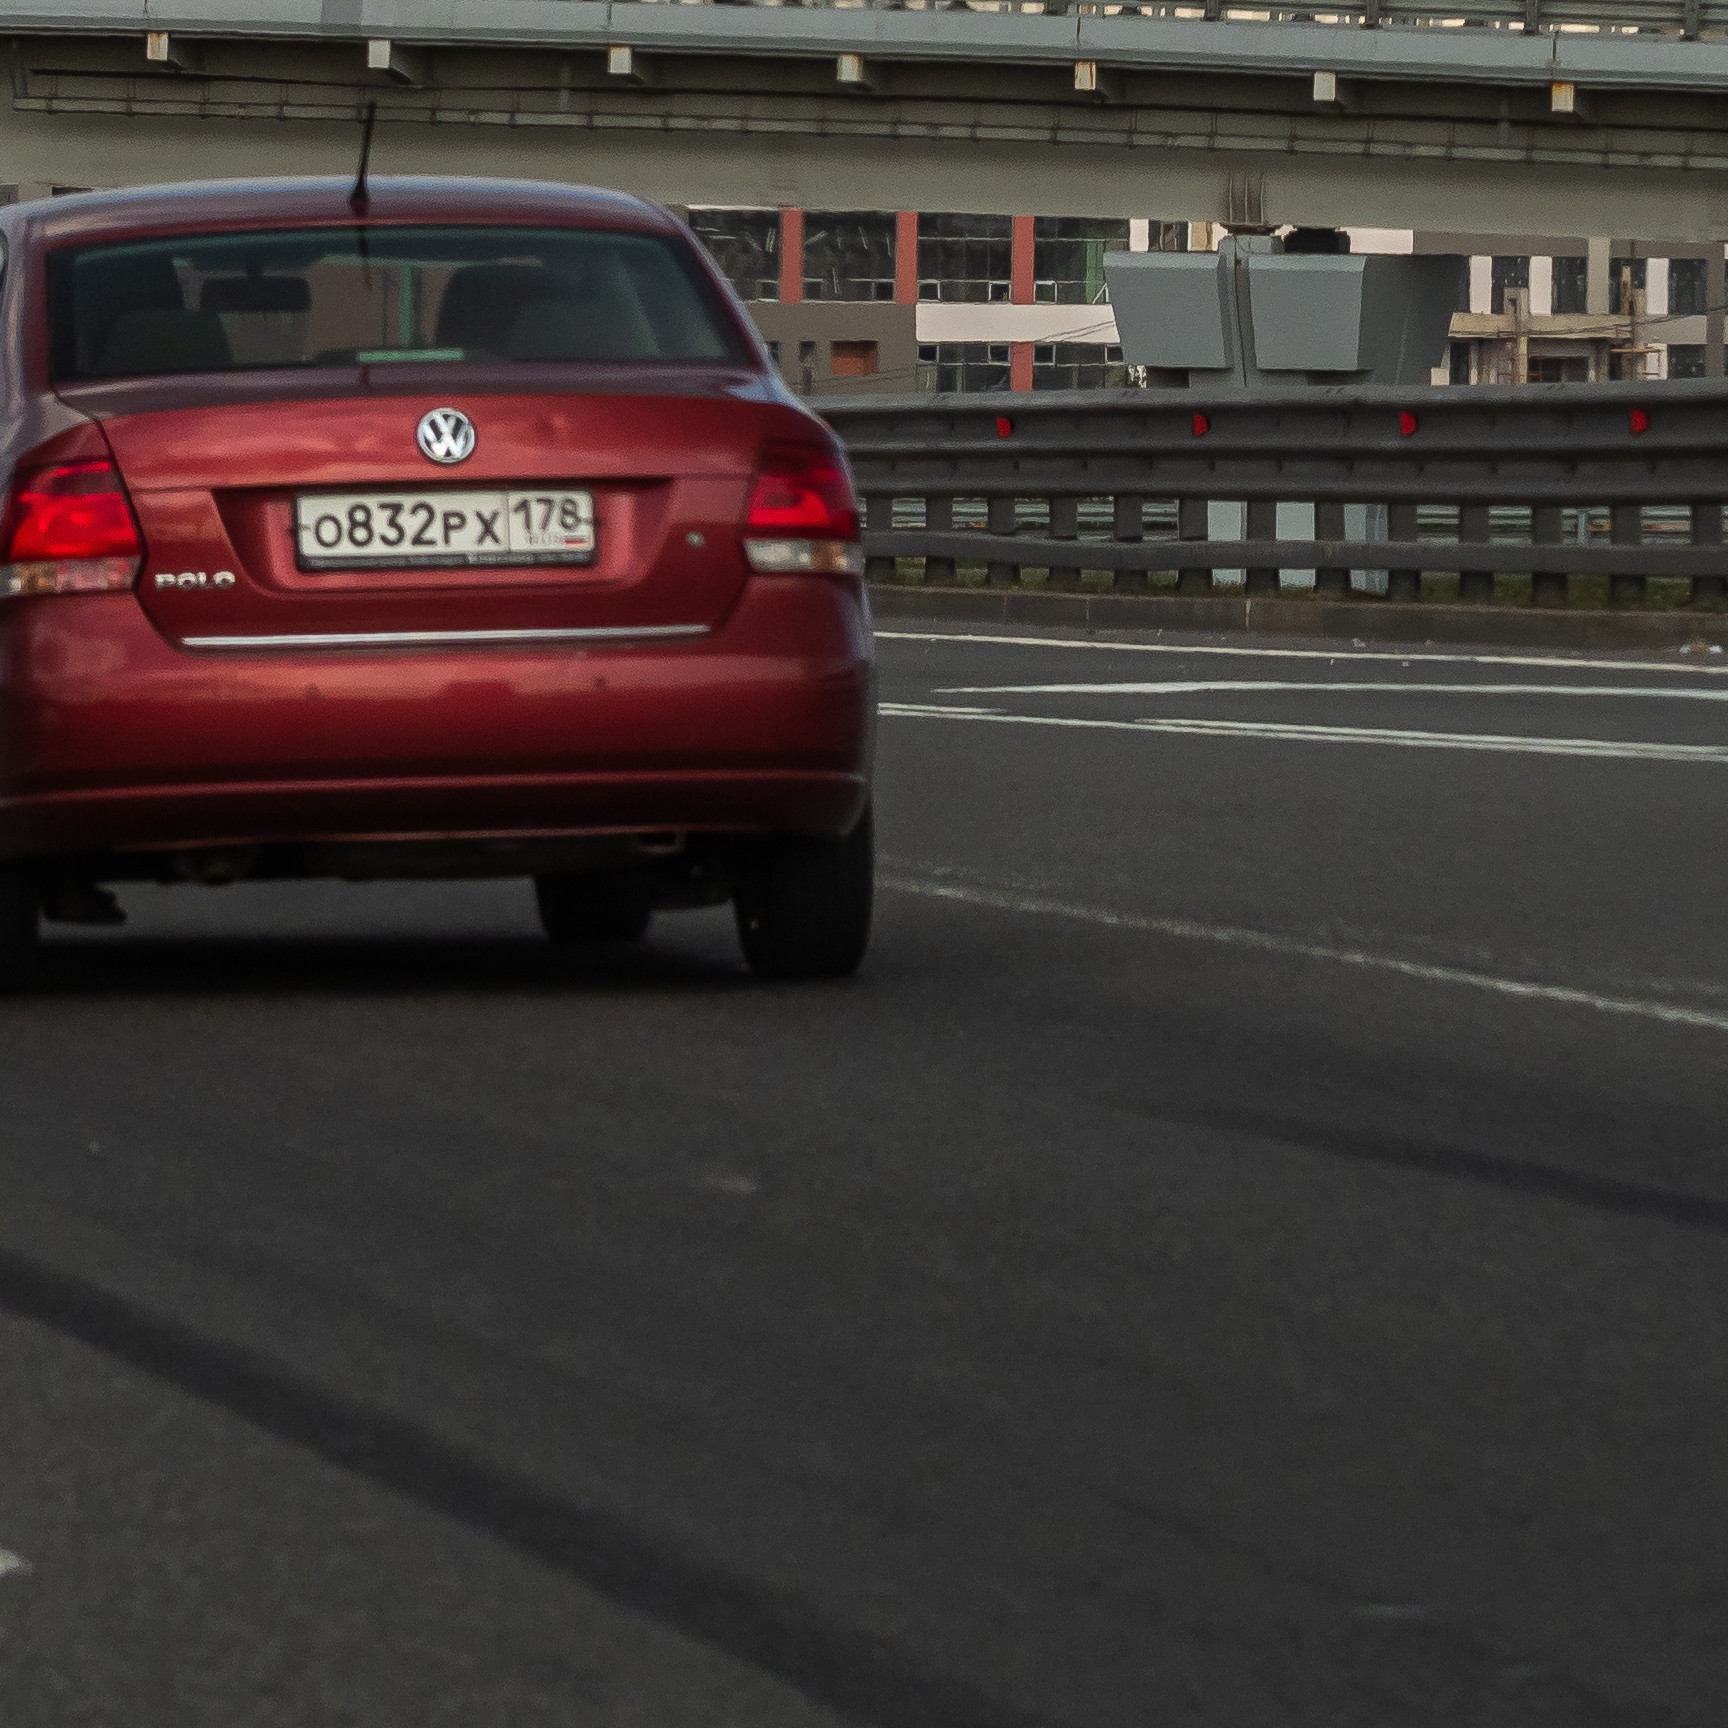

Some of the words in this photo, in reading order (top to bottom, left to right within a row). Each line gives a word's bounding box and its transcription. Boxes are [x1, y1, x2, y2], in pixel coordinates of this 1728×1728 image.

[417, 408, 475, 462] VW
[512, 497, 580, 531] 178
[154, 570, 236, 591] POLO
